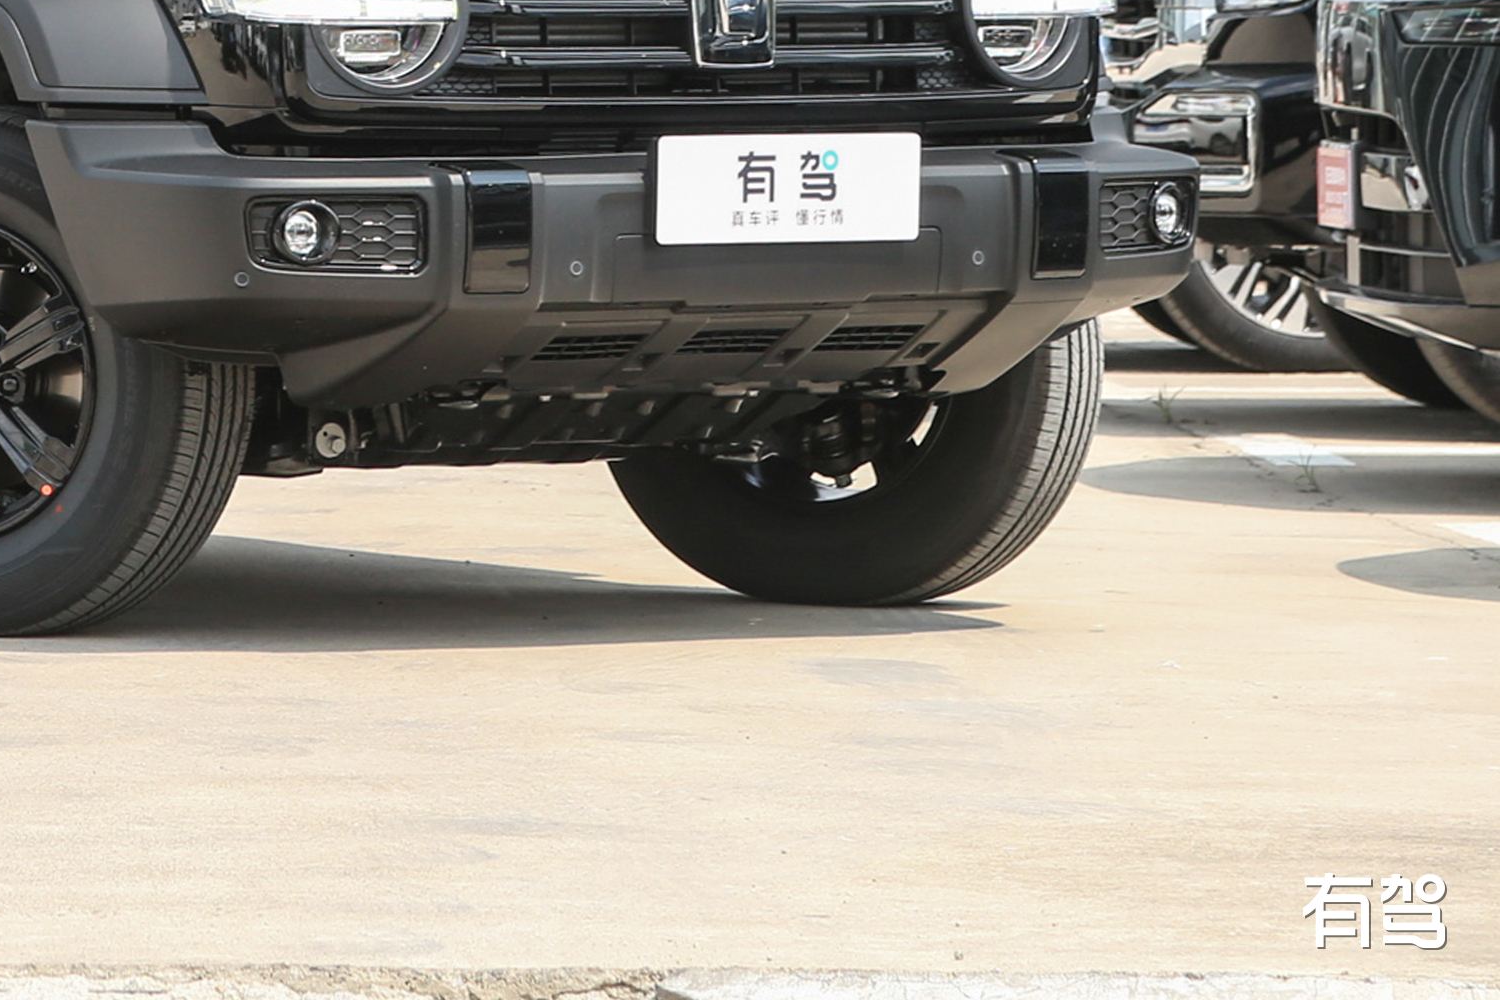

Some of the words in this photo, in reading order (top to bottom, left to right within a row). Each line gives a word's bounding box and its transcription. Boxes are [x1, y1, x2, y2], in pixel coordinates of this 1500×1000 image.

[737, 150, 839, 203] 有驾
[796, 208, 844, 226] 懂行情
